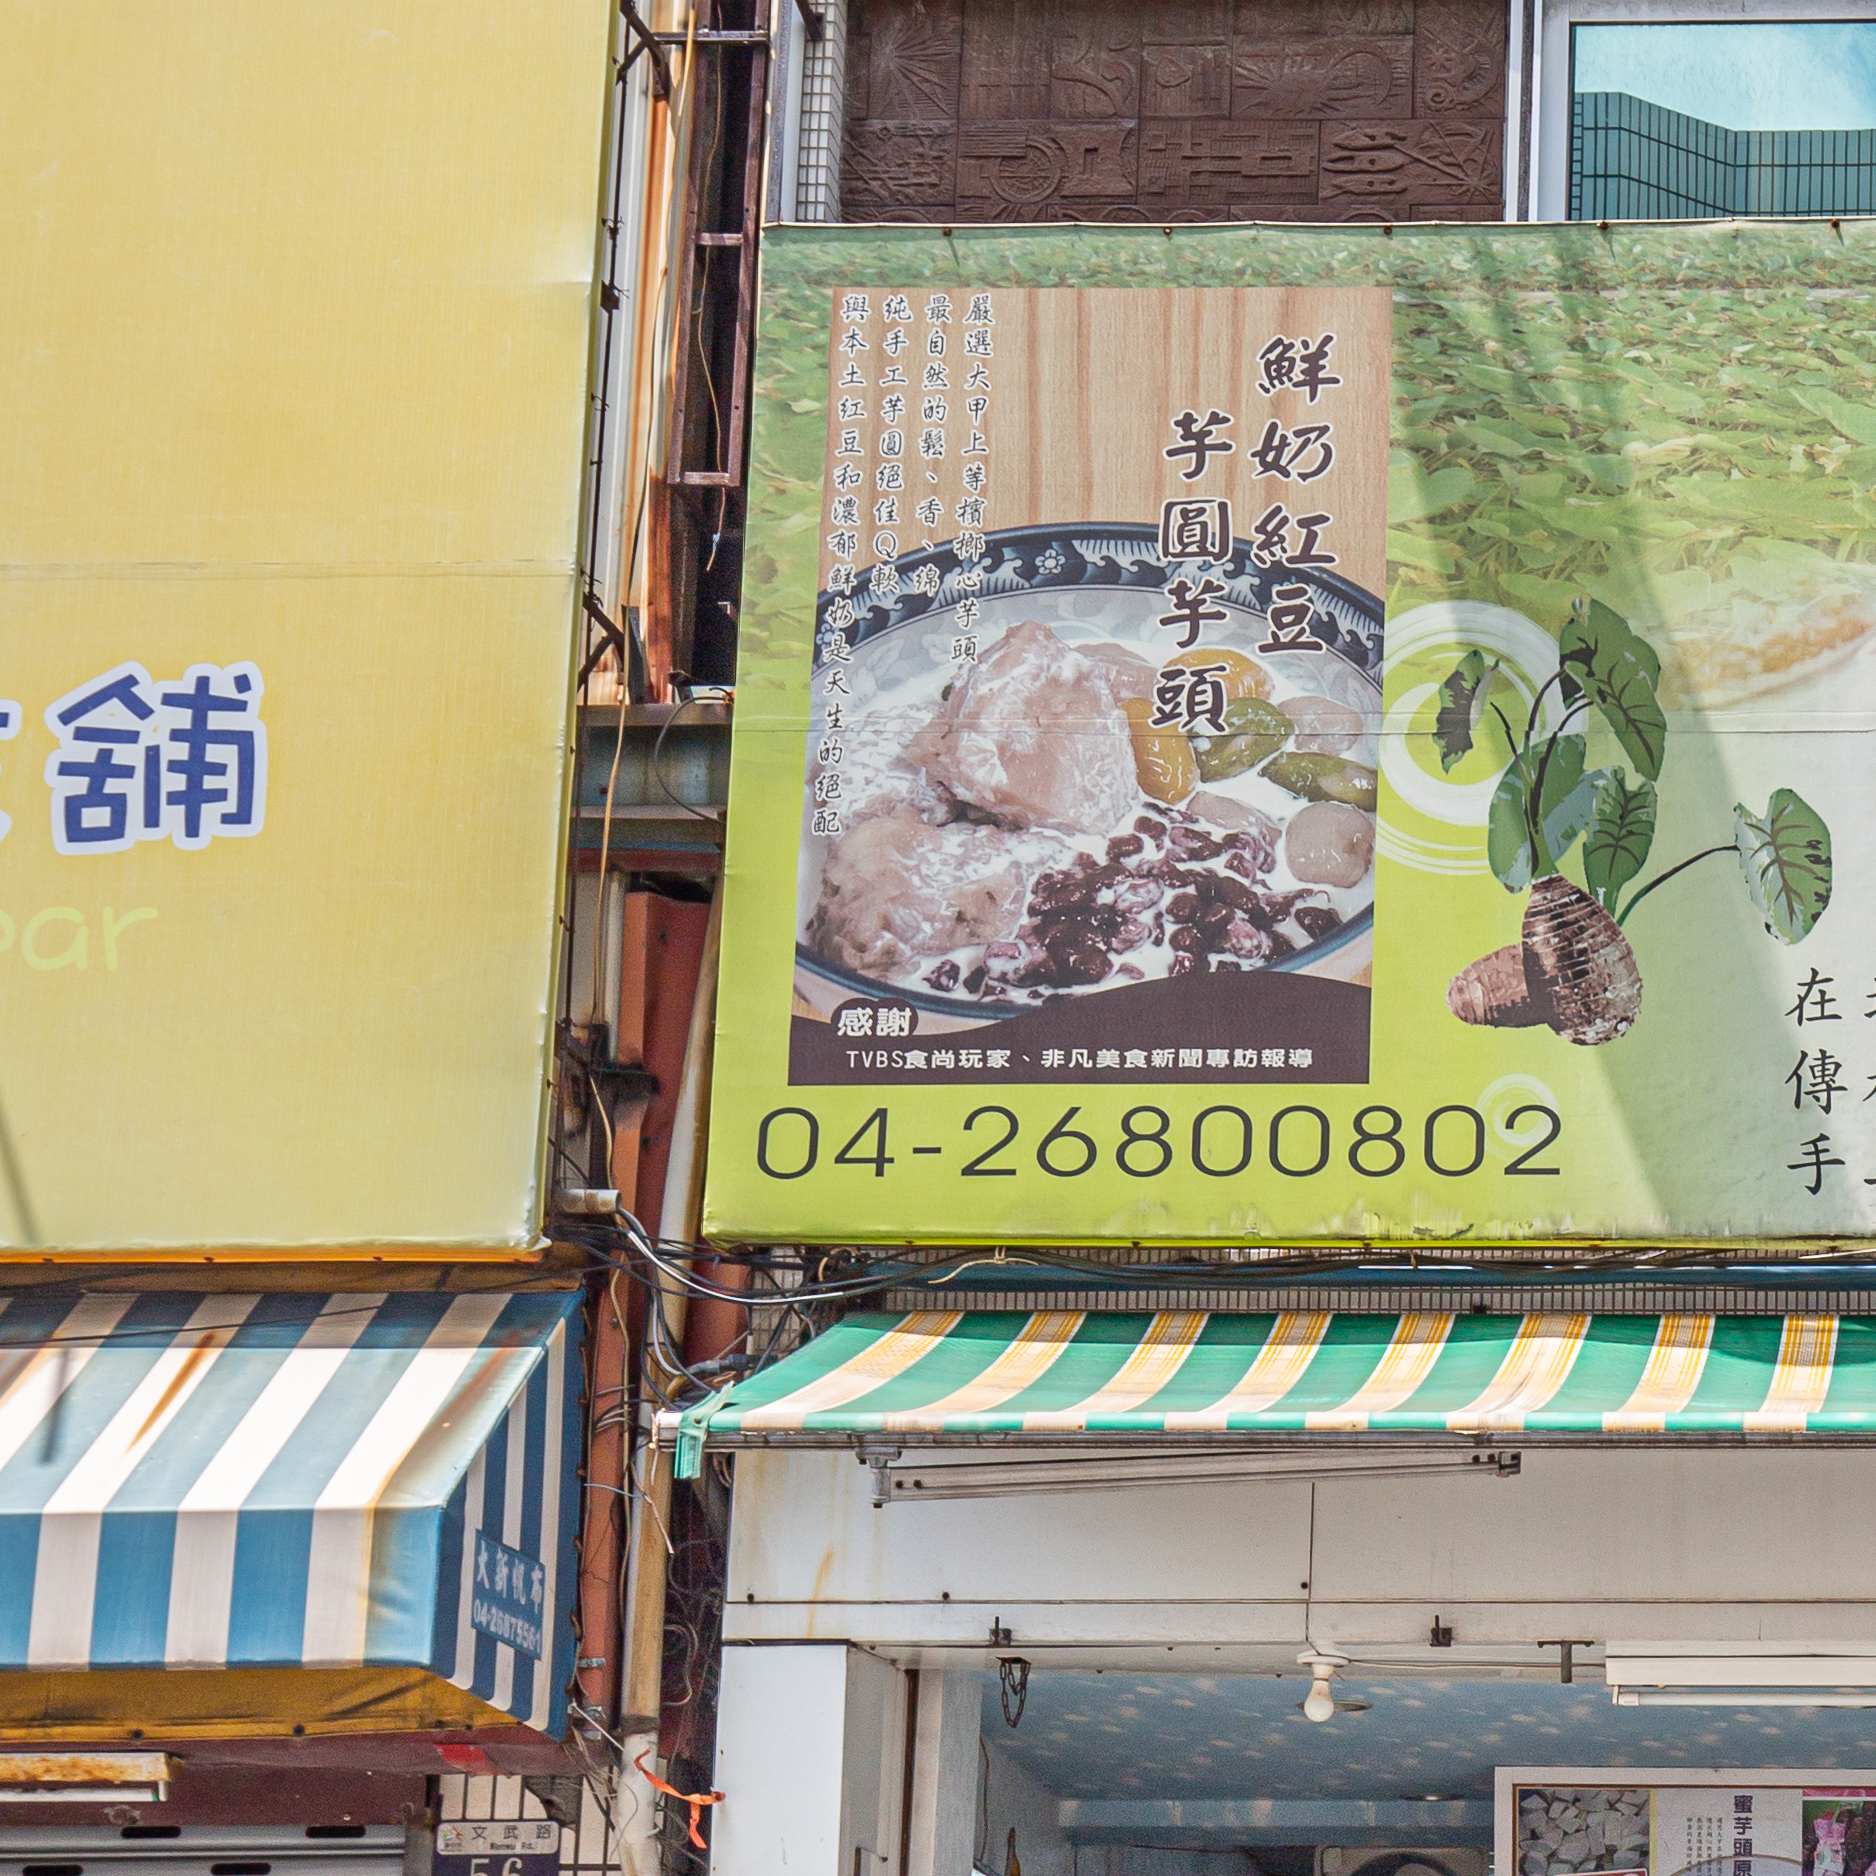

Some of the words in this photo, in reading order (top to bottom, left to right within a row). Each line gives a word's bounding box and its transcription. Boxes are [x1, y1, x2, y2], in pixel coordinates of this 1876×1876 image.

[1250, 333, 1342, 655] 鮮奶紅豆
[1149, 409, 1235, 735] 芋圓芋頭
[0, 673, 257, 843] 舖
[837, 1005, 912, 1039] 感謝
[845, 1046, 1314, 1072] TVBS食尚玩家、非凡美食新聞專訪報導
[757, 1104, 1562, 1181] 04-26800802
[471, 1824, 551, 1841] 文武路
